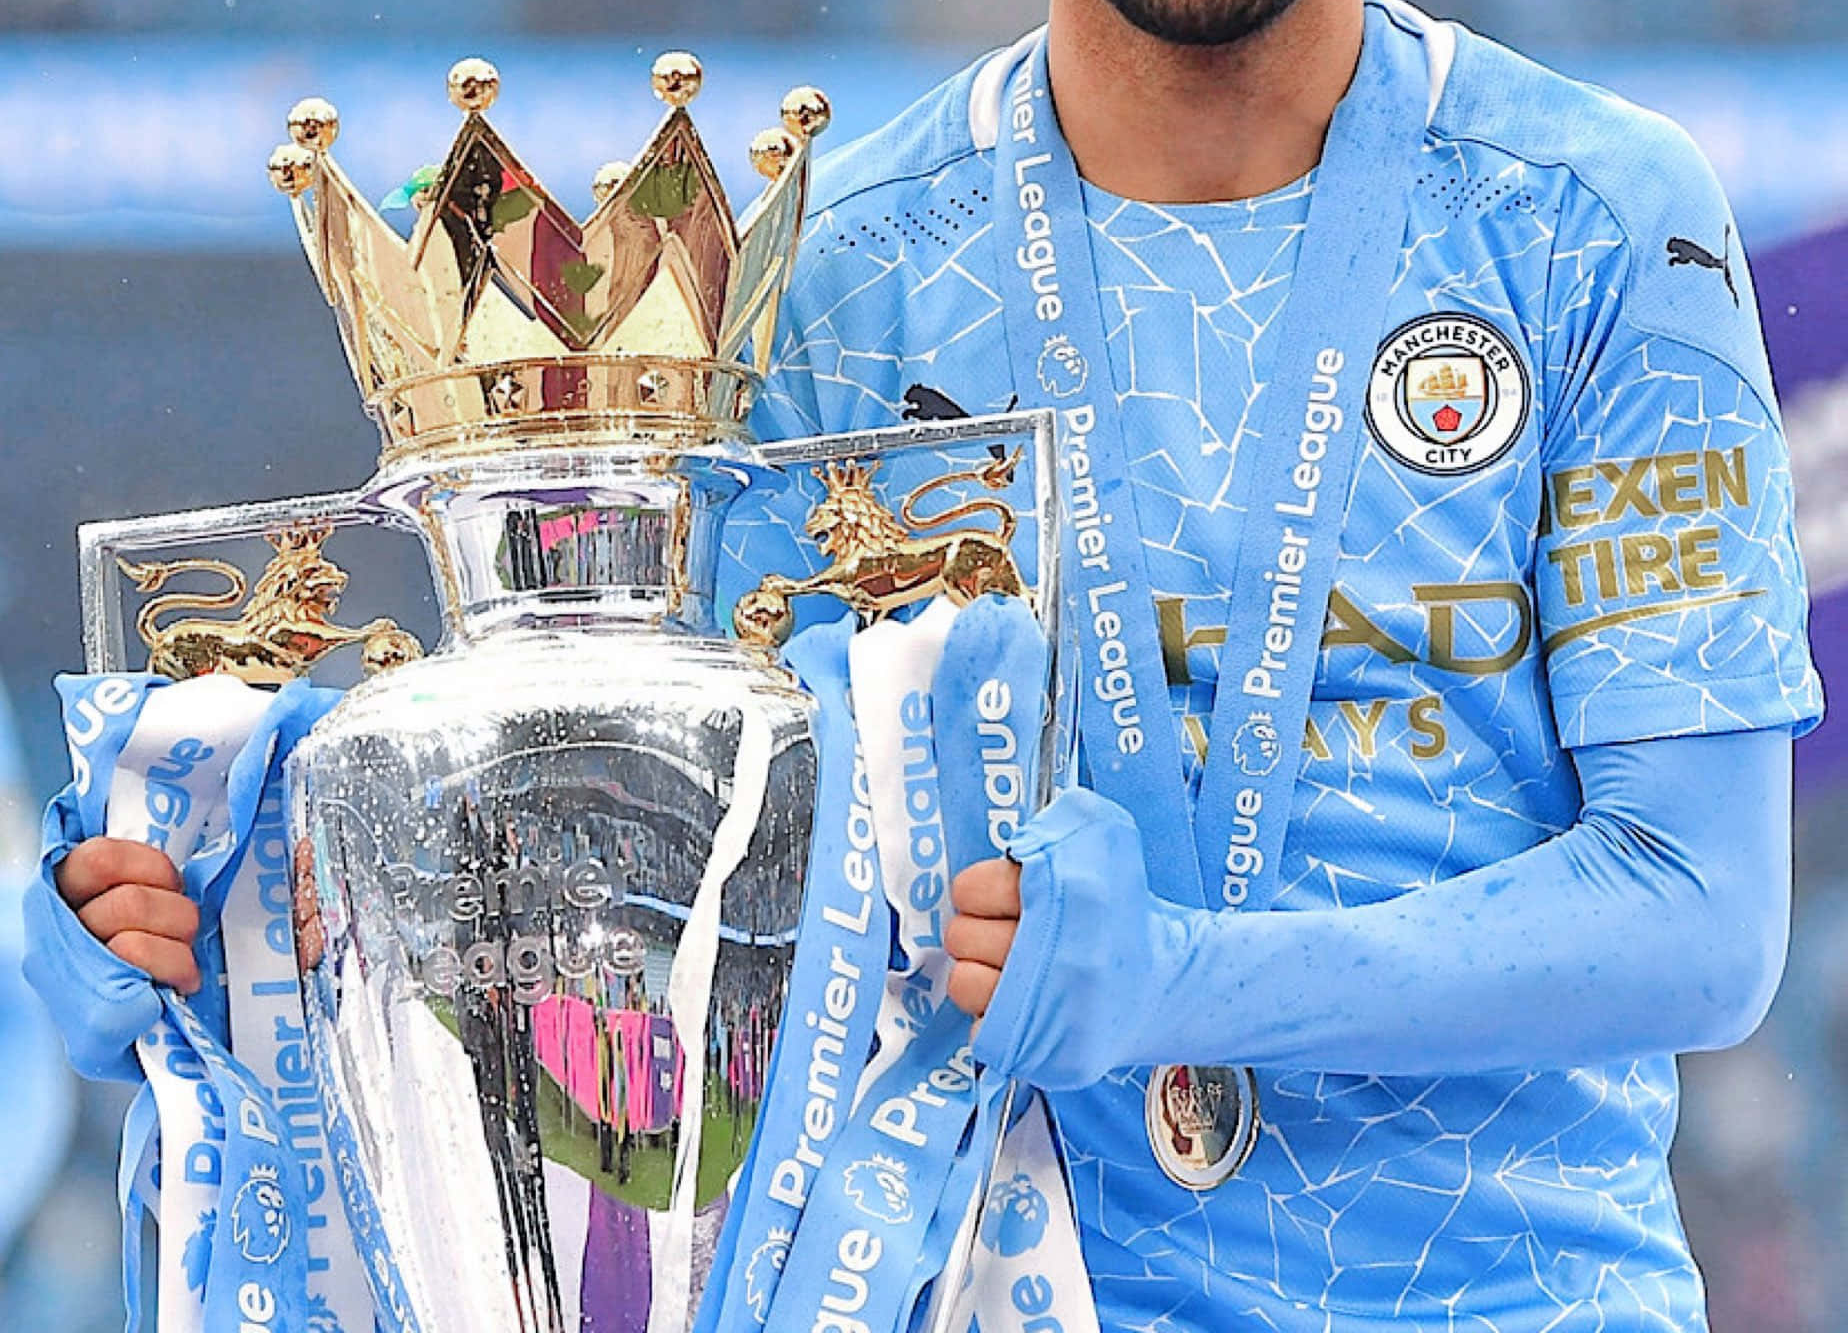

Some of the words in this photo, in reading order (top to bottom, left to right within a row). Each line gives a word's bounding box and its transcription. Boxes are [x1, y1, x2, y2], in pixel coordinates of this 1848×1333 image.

[1014, 153, 1063, 321] League
[1274, 347, 1345, 518] League
[1381, 325, 1511, 377] MANCHESTER
[1064, 404, 1113, 573] Premier
[1425, 448, 1473, 465] CITY
[1542, 445, 1750, 533] EXEN
[1242, 526, 1310, 699] Premier
[1547, 525, 1727, 607] TIRE
[1087, 580, 1144, 755] League
[1222, 787, 1263, 912] ague
[767, 946, 862, 1210] Premier
